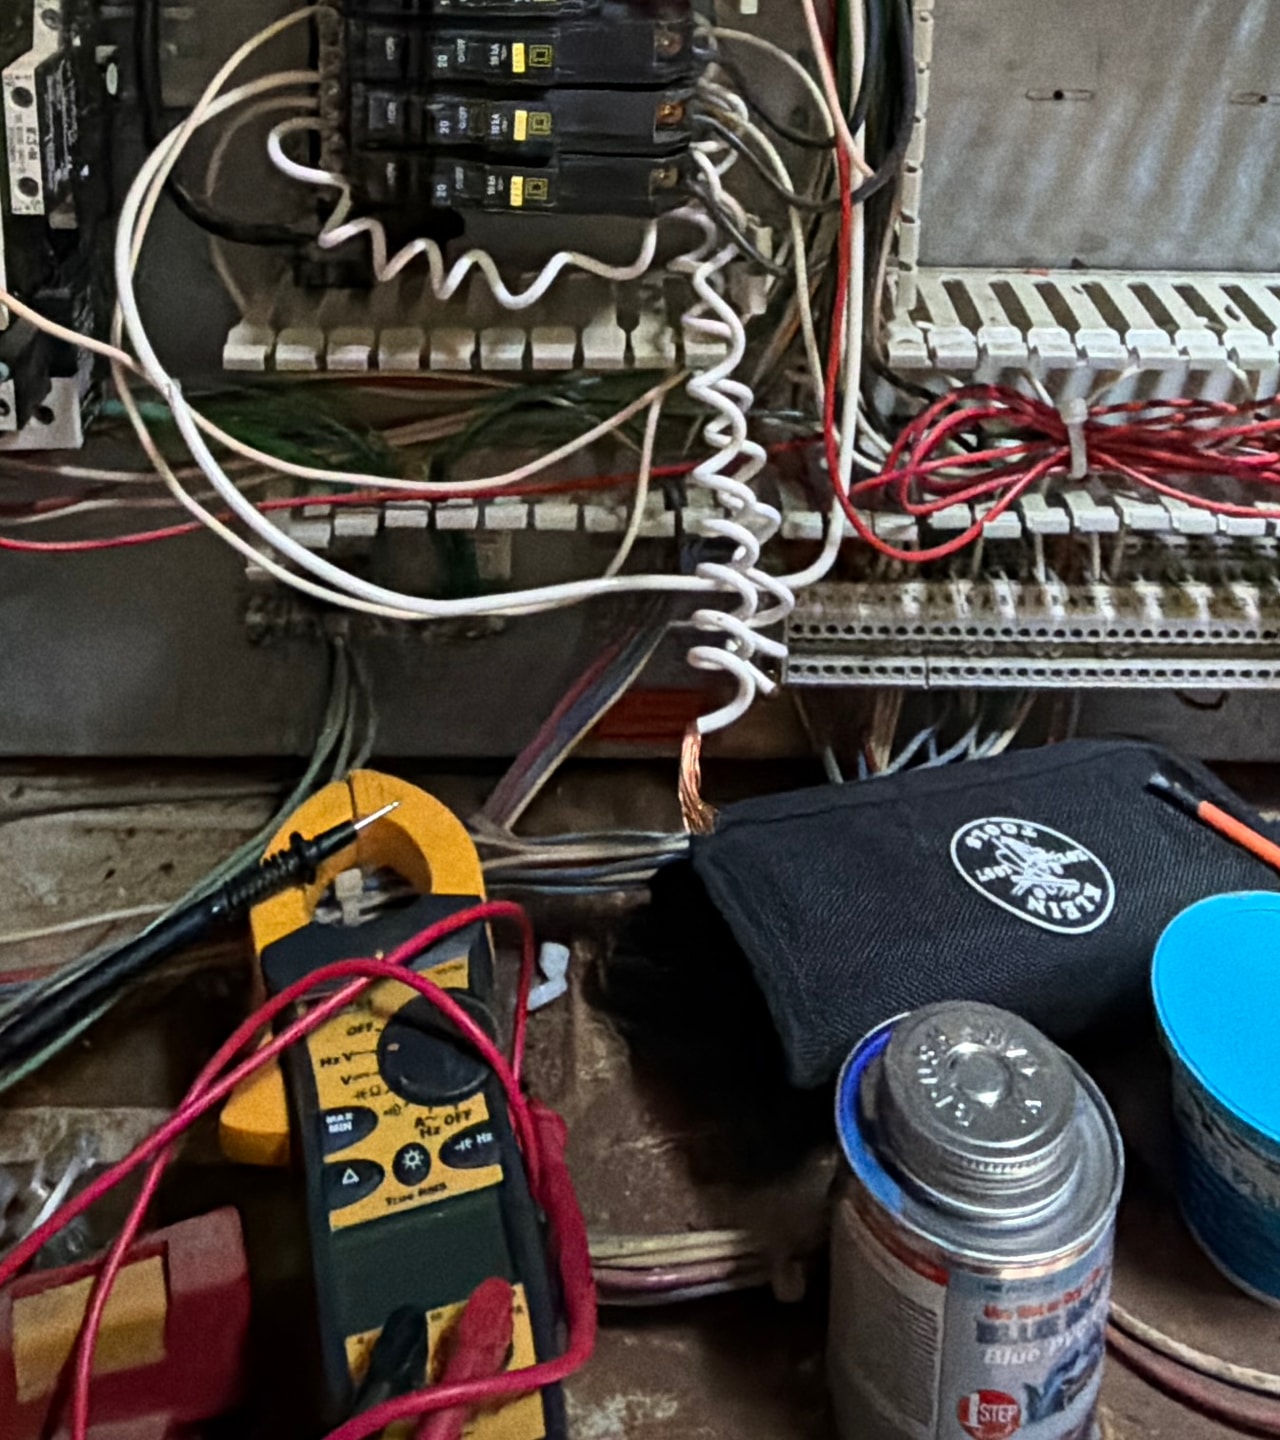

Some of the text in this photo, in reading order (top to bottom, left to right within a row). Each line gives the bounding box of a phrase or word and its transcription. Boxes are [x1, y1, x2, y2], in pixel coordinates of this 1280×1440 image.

[436, 54, 448, 68] 20
[439, 119, 451, 134] 20
[965, 823, 1038, 850] TOOLS
[1026, 882, 1102, 920] KLEIN
[346, 1021, 374, 1036] OFF
[325, 1112, 354, 1124] MAX
[444, 1109, 472, 1126] OFF
[328, 1121, 353, 1134] MIN
[979, 1402, 1018, 1423] STEP
